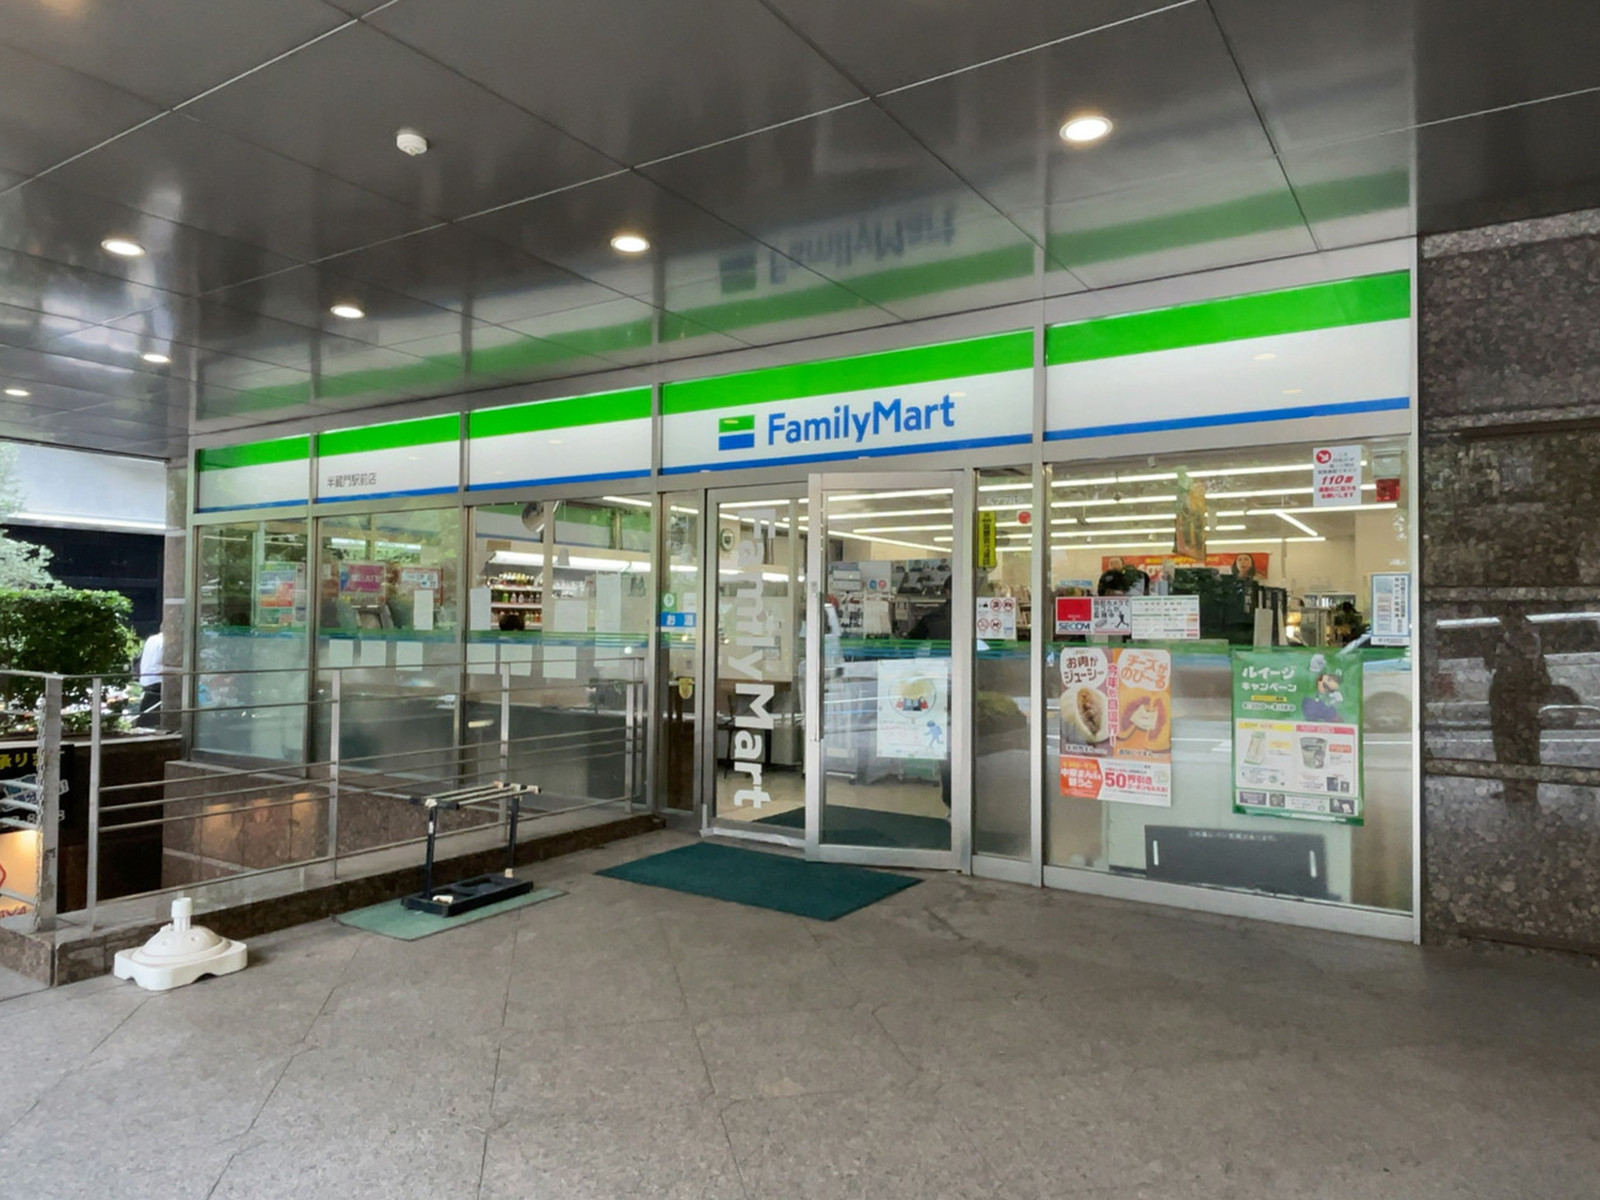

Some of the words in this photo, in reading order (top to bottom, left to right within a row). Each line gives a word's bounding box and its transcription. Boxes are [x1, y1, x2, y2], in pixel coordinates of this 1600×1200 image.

[768, 394, 955, 446] FamilyMart
[666, 613, 694, 626] お酒
[1058, 622, 1091, 631] SECOM
[728, 508, 776, 809] FamilyMart
[1066, 655, 1099, 669] お肉が
[1127, 654, 1168, 673] チーズが
[1063, 668, 1104, 684] ジューシー
[1242, 665, 1296, 680] ルイージ
[1242, 682, 1297, 693] キャンペーン
